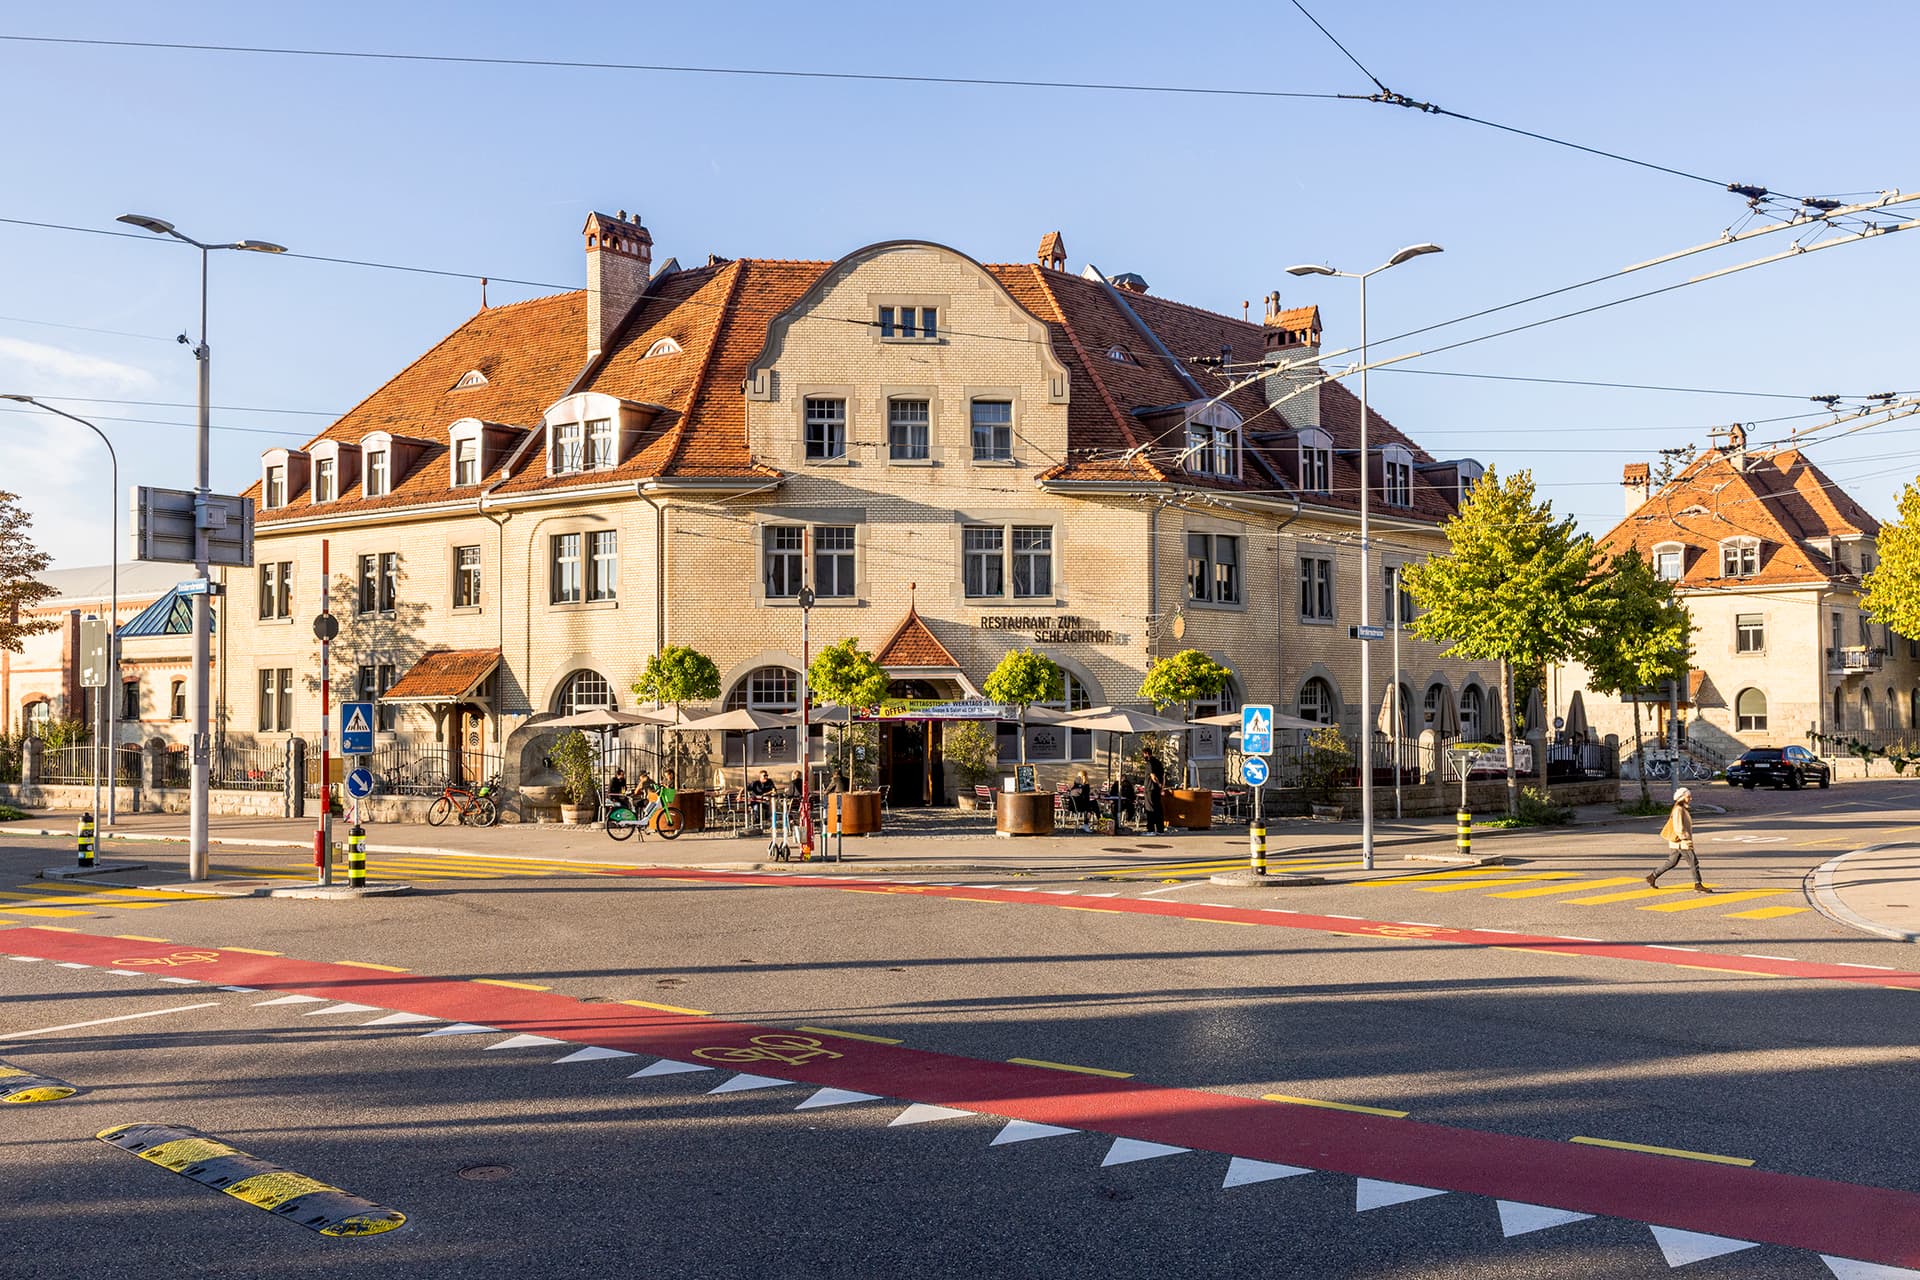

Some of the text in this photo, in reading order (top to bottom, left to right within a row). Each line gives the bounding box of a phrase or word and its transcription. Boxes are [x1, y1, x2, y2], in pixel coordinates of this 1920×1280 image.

[981, 616, 1080, 629] RESTAURANT ZUM
[1035, 630, 1112, 643] SCHLACHTHOF
[885, 705, 907, 716] OFFEN
